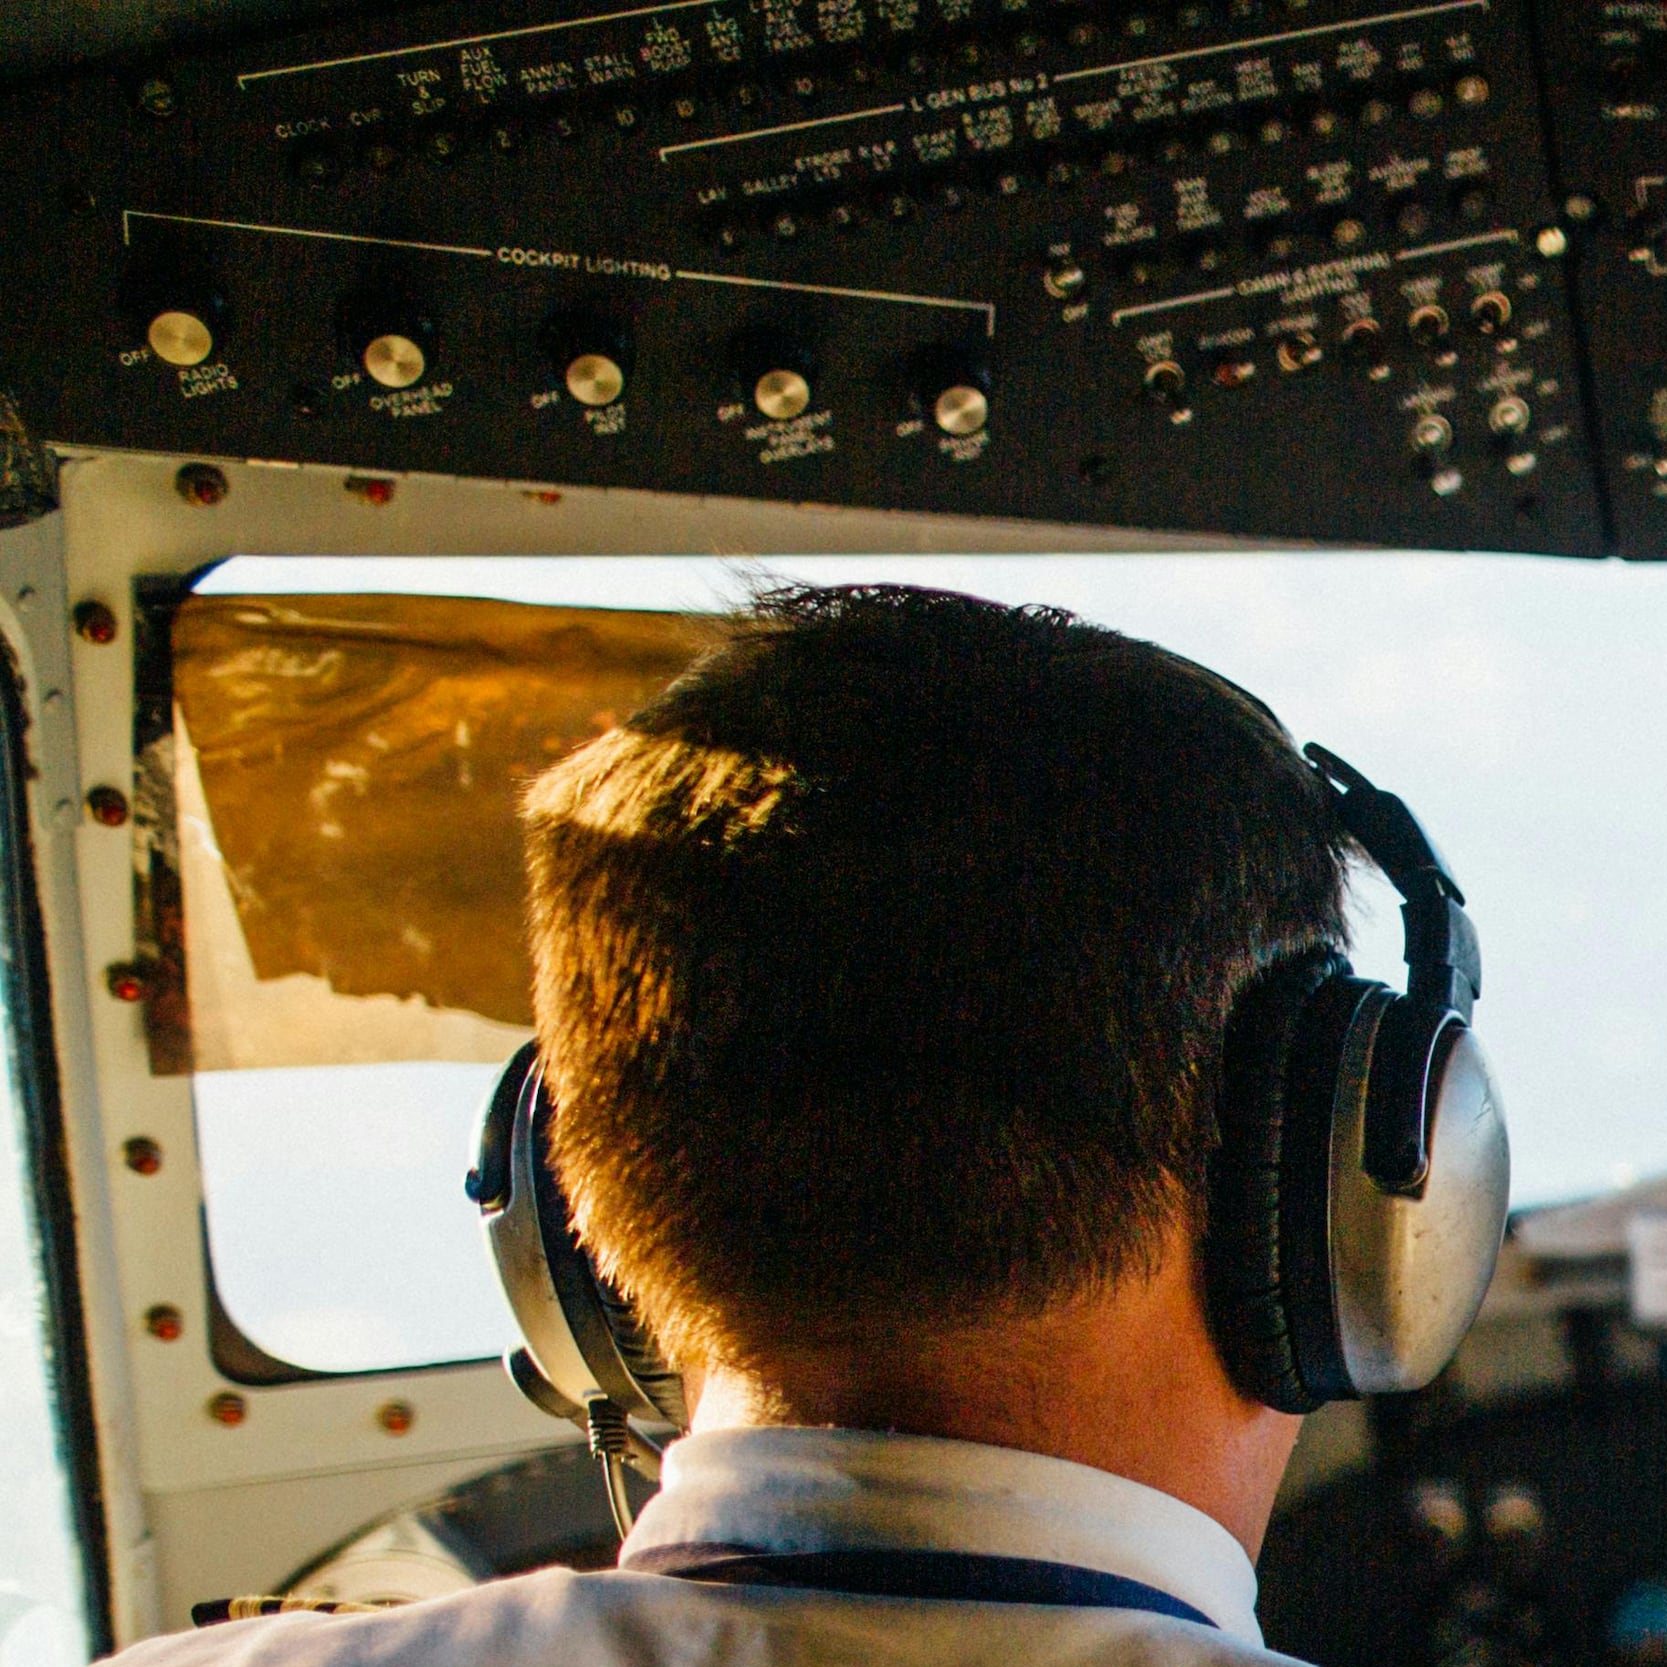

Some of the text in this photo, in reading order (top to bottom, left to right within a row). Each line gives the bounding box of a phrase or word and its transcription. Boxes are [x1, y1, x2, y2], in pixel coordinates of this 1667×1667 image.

[461, 46, 493, 62] AUX
[583, 53, 632, 72] STALL
[460, 60, 501, 76] FUEL
[520, 61, 574, 82] ANNUN
[397, 69, 441, 87] TURN
[462, 73, 508, 91] FLOW
[910, 97, 923, 112] L
[275, 117, 331, 138] CLOCK
[497, 246, 672, 281] COCKPIT LIGHTING
[119, 348, 150, 367] OFF
[178, 362, 229, 383] RADIO
[331, 372, 361, 390] OFF
[180, 375, 239, 399] LIGHTS
